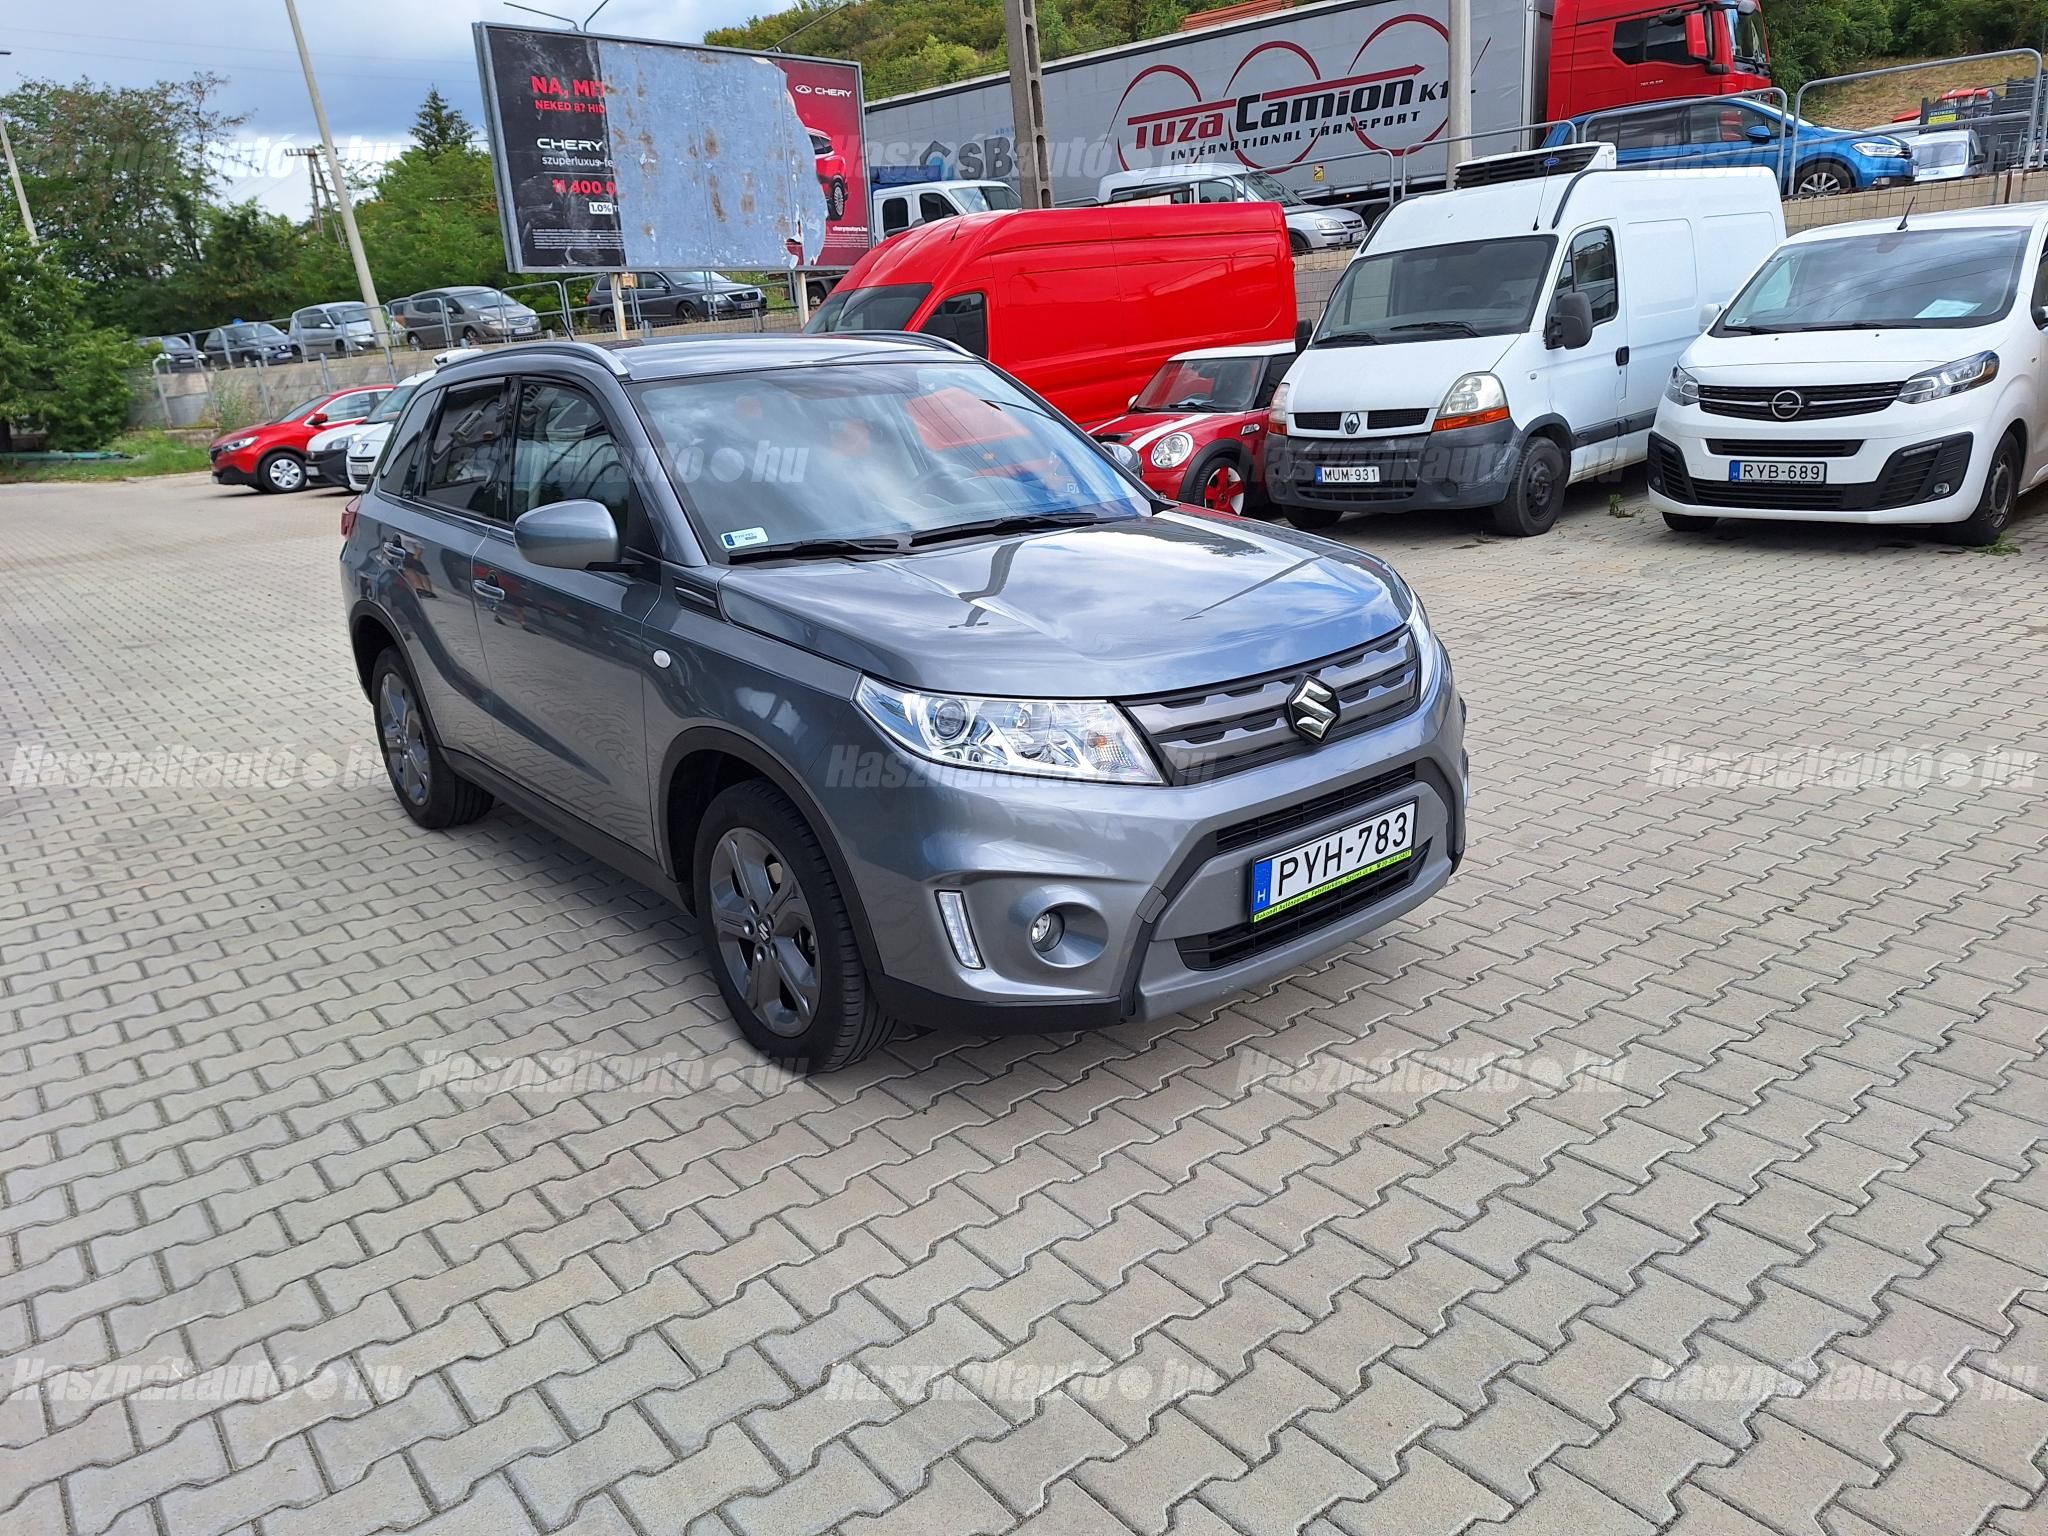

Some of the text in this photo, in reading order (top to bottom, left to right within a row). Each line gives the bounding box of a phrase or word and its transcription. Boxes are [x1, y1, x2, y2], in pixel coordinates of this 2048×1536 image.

[531, 76, 569, 99] NA,
[815, 87, 852, 97] CHERY
[535, 100, 571, 111] NEKED
[1236, 79, 1414, 132] Camion
[1171, 110, 1420, 160] INTERNATIONAL TRANSPORT
[537, 138, 603, 151] CHERY
[571, 179, 602, 194] 400
[591, 204, 612, 213] 1.0%
[1324, 469, 1376, 481] MUM-931
[1743, 464, 1820, 480] RYB-689
[1278, 811, 1408, 897] PYH-783
